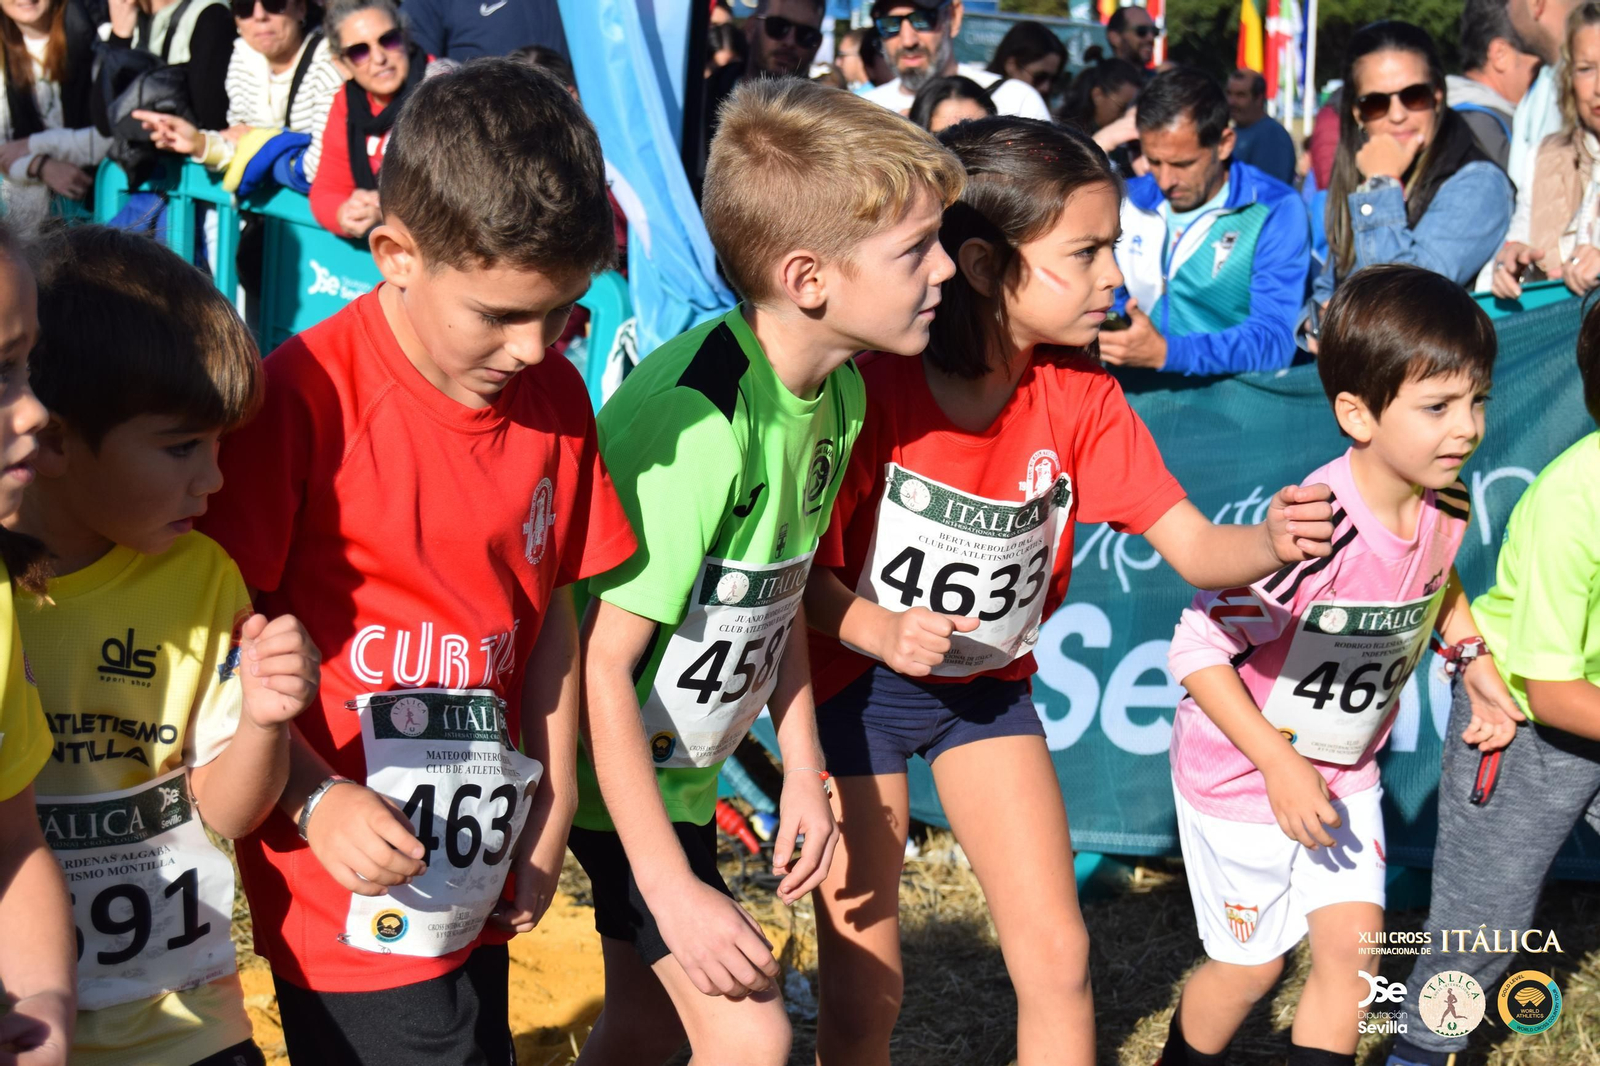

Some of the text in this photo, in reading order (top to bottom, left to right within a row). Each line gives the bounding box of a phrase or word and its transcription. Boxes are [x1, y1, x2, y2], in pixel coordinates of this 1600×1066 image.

[944, 497, 1040, 533] ITÁLICA
[918, 535, 943, 550] CLUB
[945, 544, 959, 556] DE
[962, 549, 1016, 562] ATLETISMO
[939, 532, 971, 549] BERTA
[973, 543, 1016, 553] REBOLLO
[880, 545, 1049, 622] 4633
[719, 624, 743, 634] CLUB
[735, 613, 765, 625] JUANJO
[1333, 641, 1372, 650] RODRIGO
[442, 698, 500, 733] ITÁLI
[426, 750, 460, 761] MATEO
[426, 764, 452, 775] CLUB
[452, 765, 463, 775] DE
[40, 805, 147, 843] ÁLICA
[59, 844, 172, 871] RDENAS ALGABA
[64, 857, 176, 883] TISMO MONTILLA
